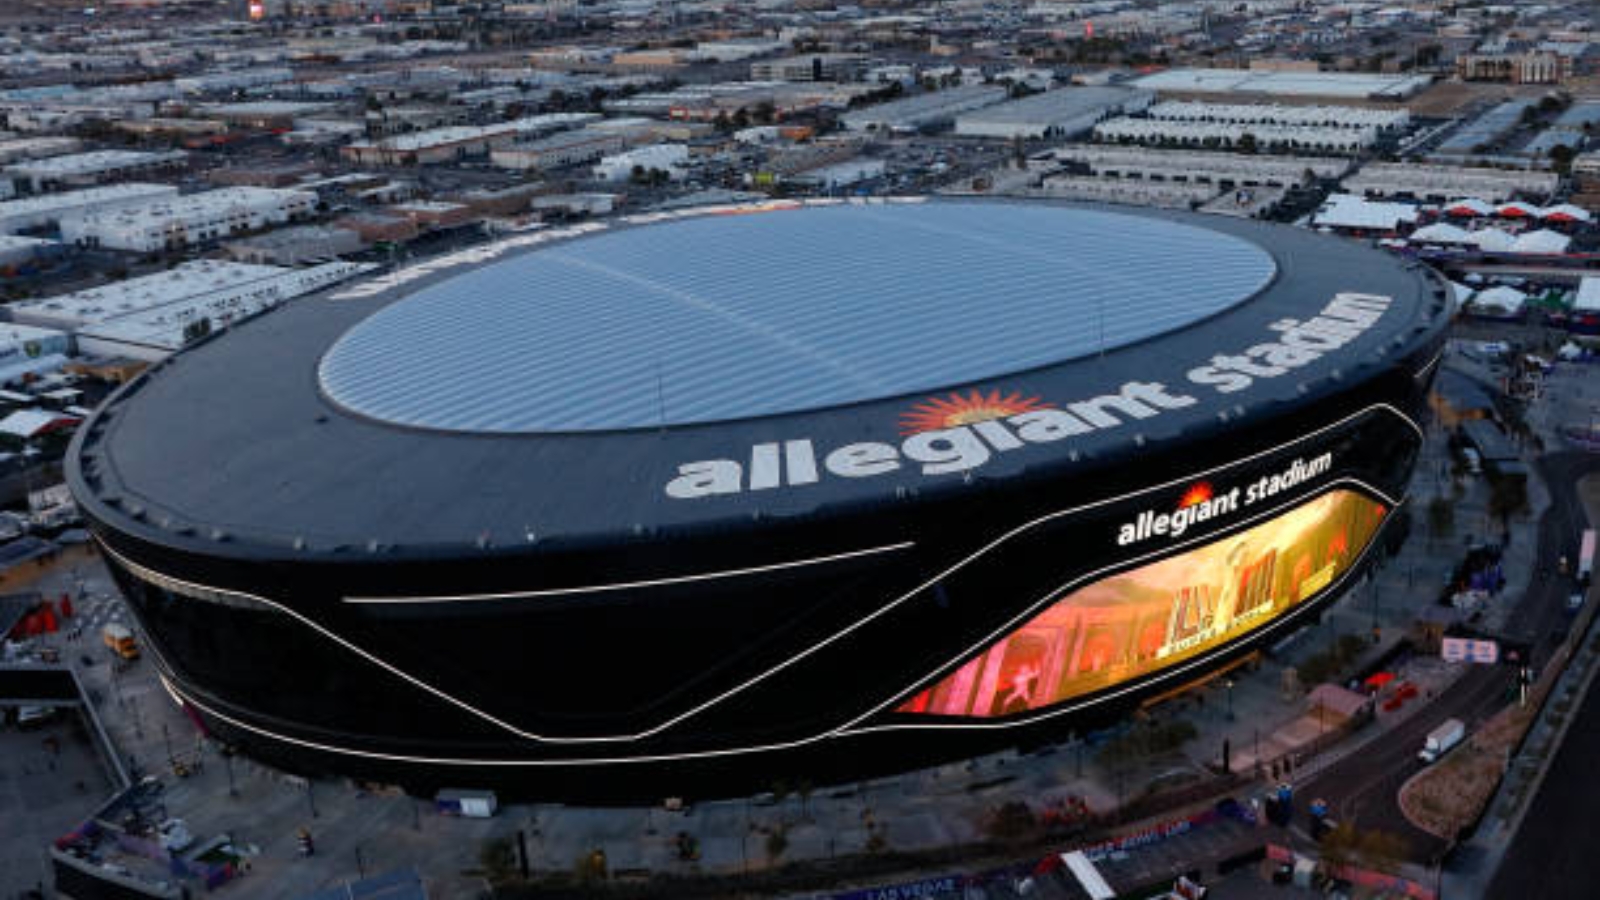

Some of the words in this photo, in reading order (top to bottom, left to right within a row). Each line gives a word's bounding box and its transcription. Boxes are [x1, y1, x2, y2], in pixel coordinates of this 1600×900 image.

[665, 381, 1197, 498] allegiant
[1187, 291, 1393, 393] stadium
[1117, 487, 1240, 546] allegiant
[1244, 452, 1332, 505] stadium
